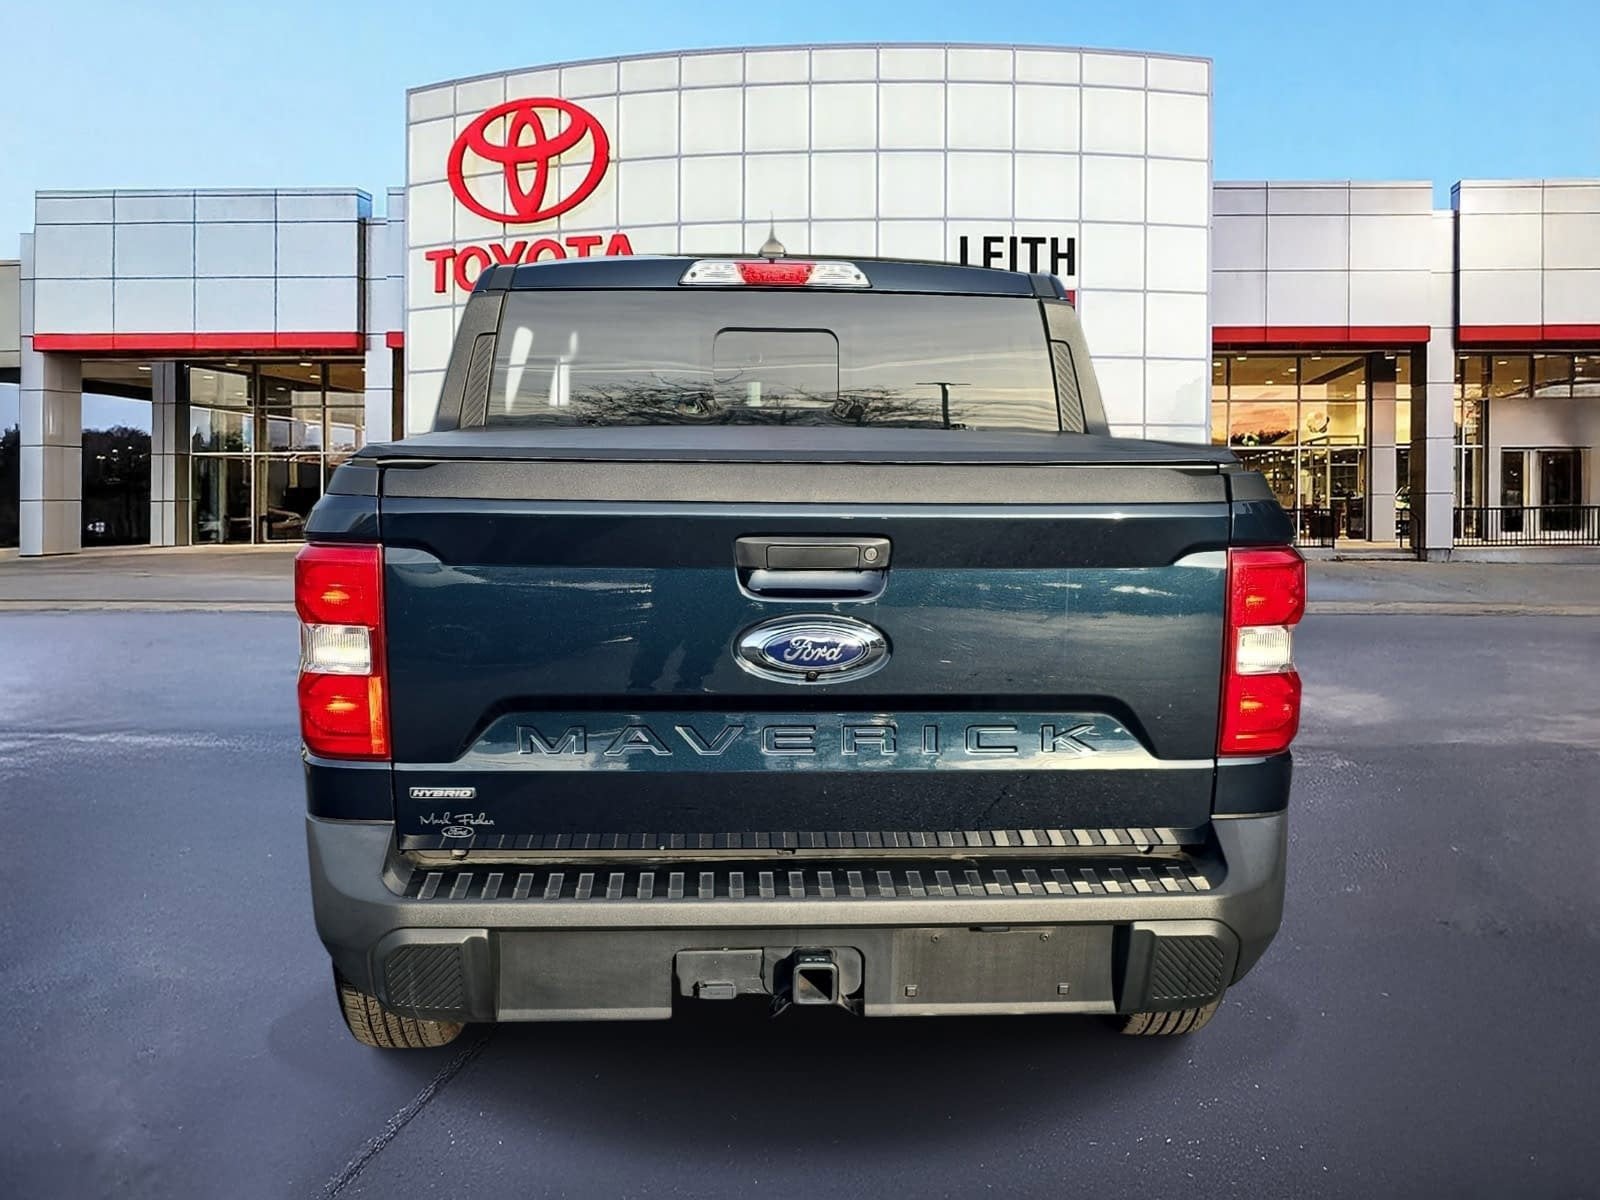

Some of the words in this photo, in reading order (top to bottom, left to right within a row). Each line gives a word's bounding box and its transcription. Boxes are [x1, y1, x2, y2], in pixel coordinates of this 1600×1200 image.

[959, 235, 1076, 276] LEITH
[783, 636, 843, 662] Ford
[515, 723, 1100, 756] MAVERICK
